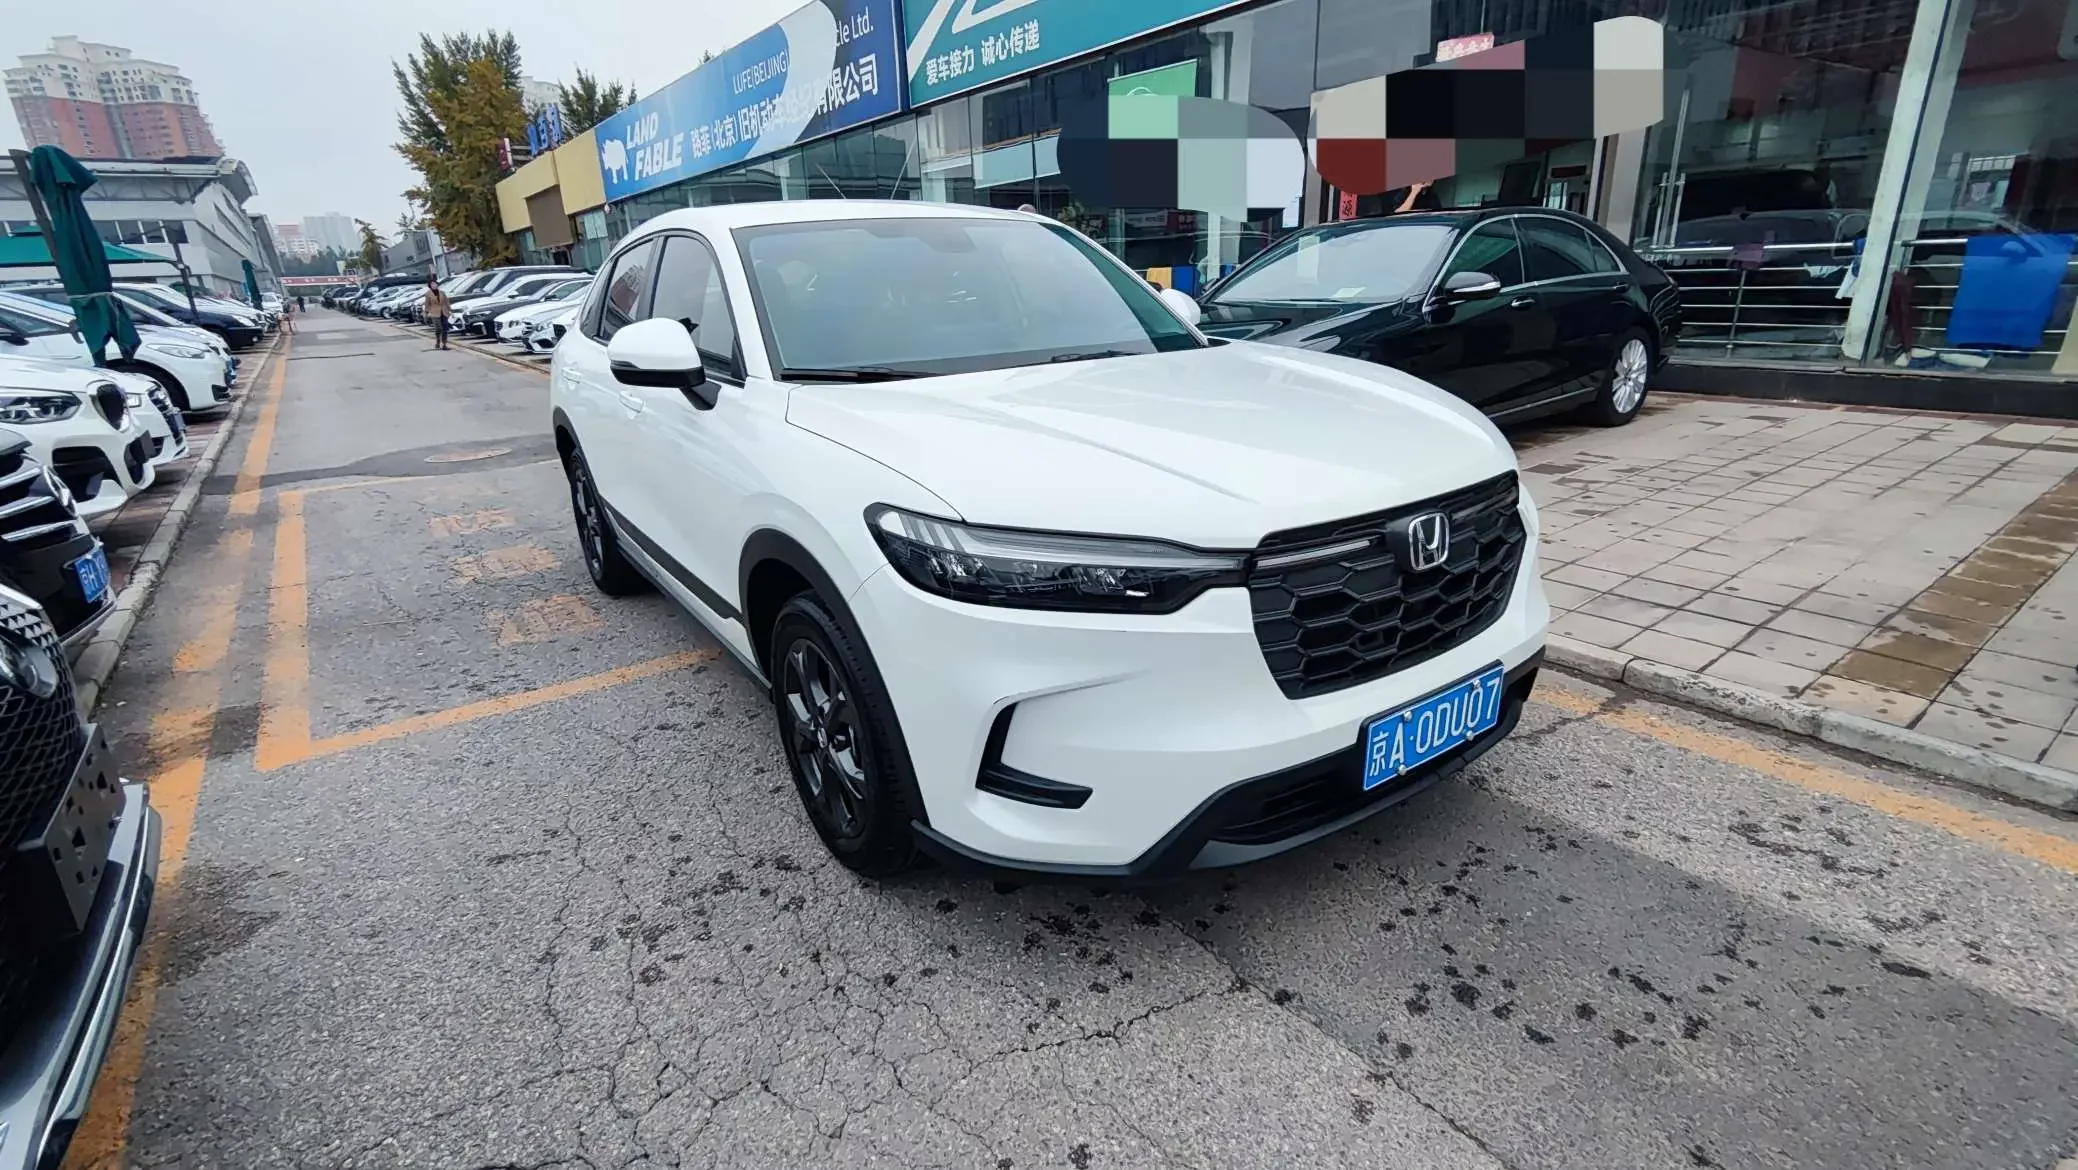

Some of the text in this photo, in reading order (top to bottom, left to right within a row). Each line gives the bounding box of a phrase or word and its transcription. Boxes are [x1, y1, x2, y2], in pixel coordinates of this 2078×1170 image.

[851, 6, 874, 39] Ltd.
[926, 19, 1040, 86] 爱车接力 诚心传递
[626, 112, 659, 149] LAND
[635, 132, 684, 181] FABLE
